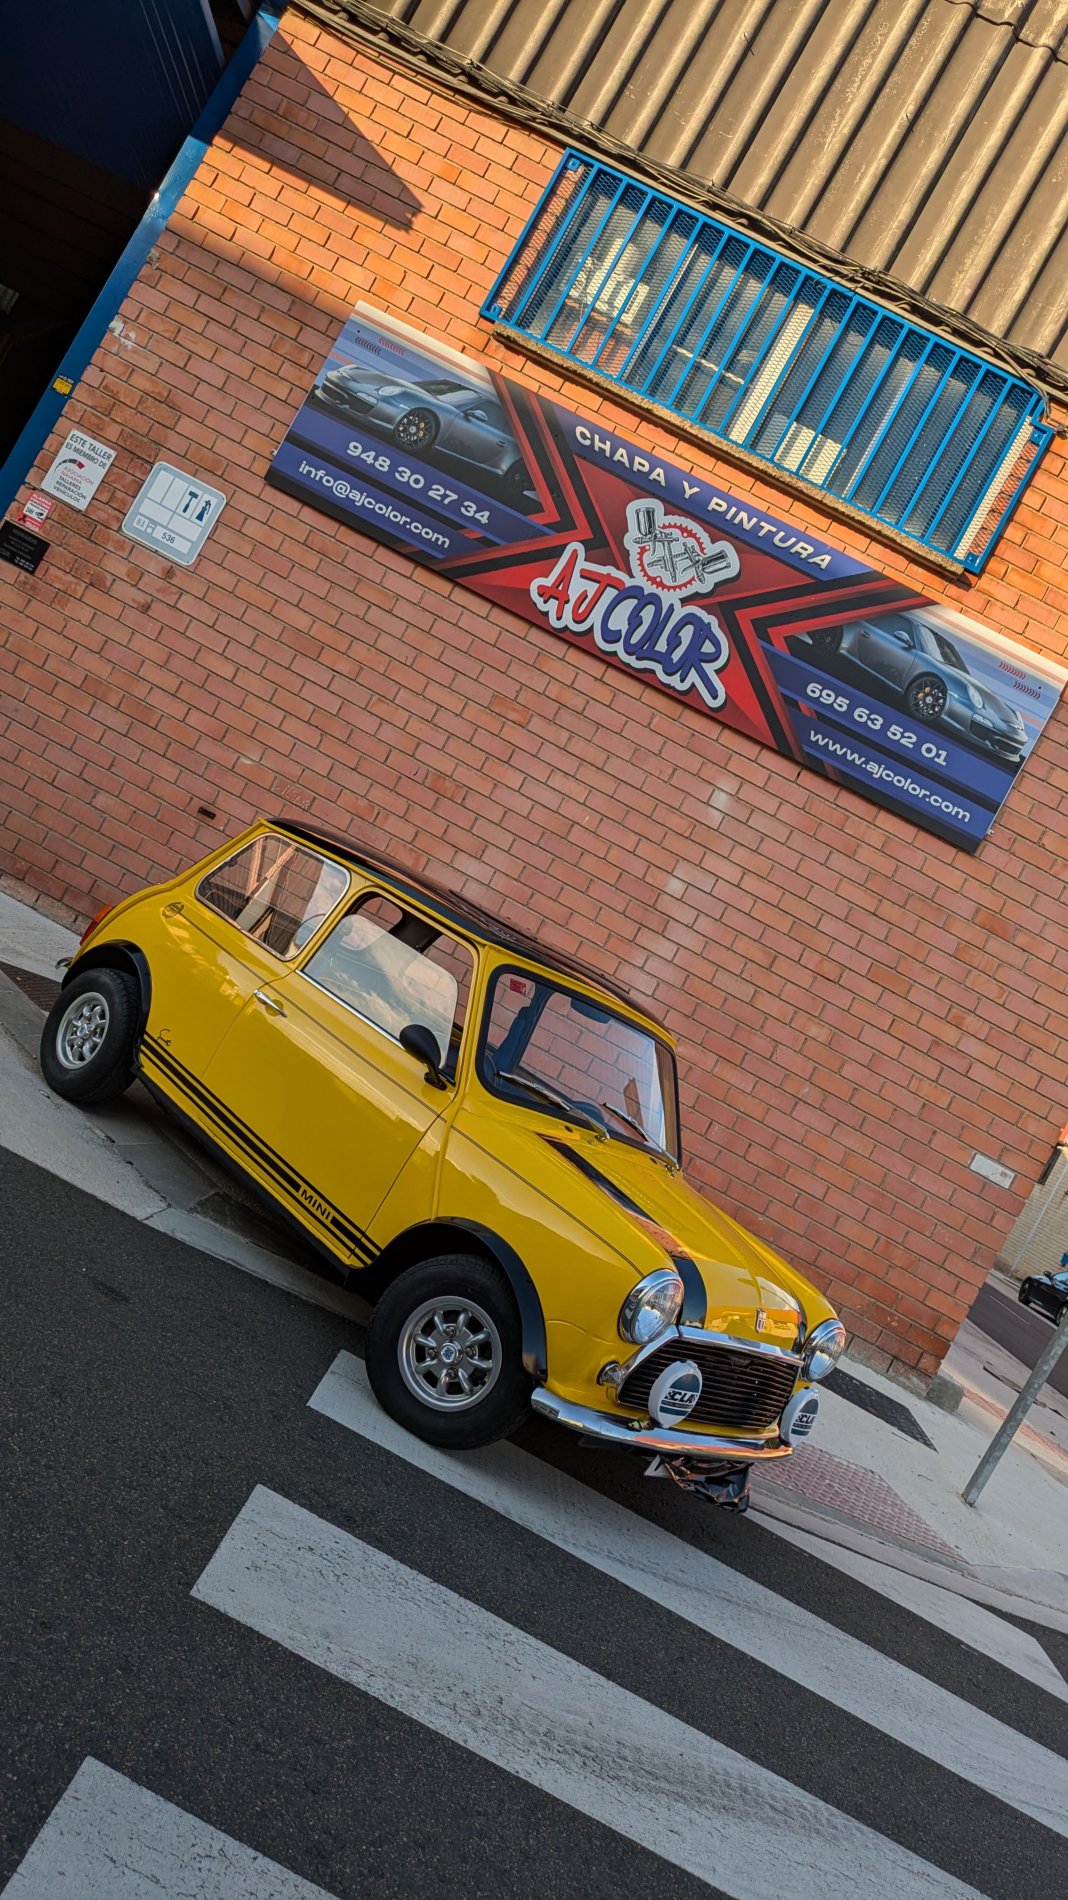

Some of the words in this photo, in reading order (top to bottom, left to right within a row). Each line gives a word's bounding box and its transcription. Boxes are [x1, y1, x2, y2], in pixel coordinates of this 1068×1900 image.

[64, 442, 73, 450] ES
[72, 446, 99, 464] MIEMBRO
[98, 460, 107, 469] DE
[69, 433, 87, 447] ESTE
[86, 442, 112, 461] TALLER
[52, 484, 80, 502] VEHÍCULOS
[58, 475, 81, 490] TALLERES
[346, 441, 390, 472] 948
[395, 466, 425, 489] 30
[428, 484, 458, 505] 27
[460, 501, 490, 524] 34
[575, 426, 666, 487] CHAPA
[682, 480, 700, 500] Y
[707, 500, 831, 570] PINTURA
[299, 461, 450, 549] info@ajcolor.com
[160, 531, 176, 544] 536
[806, 682, 849, 713] 695
[853, 706, 883, 731] 63
[887, 724, 917, 749] 52
[921, 742, 948, 767] 01
[810, 728, 971, 823] www.ajcolor.com
[300, 1188, 332, 1220] MINI
